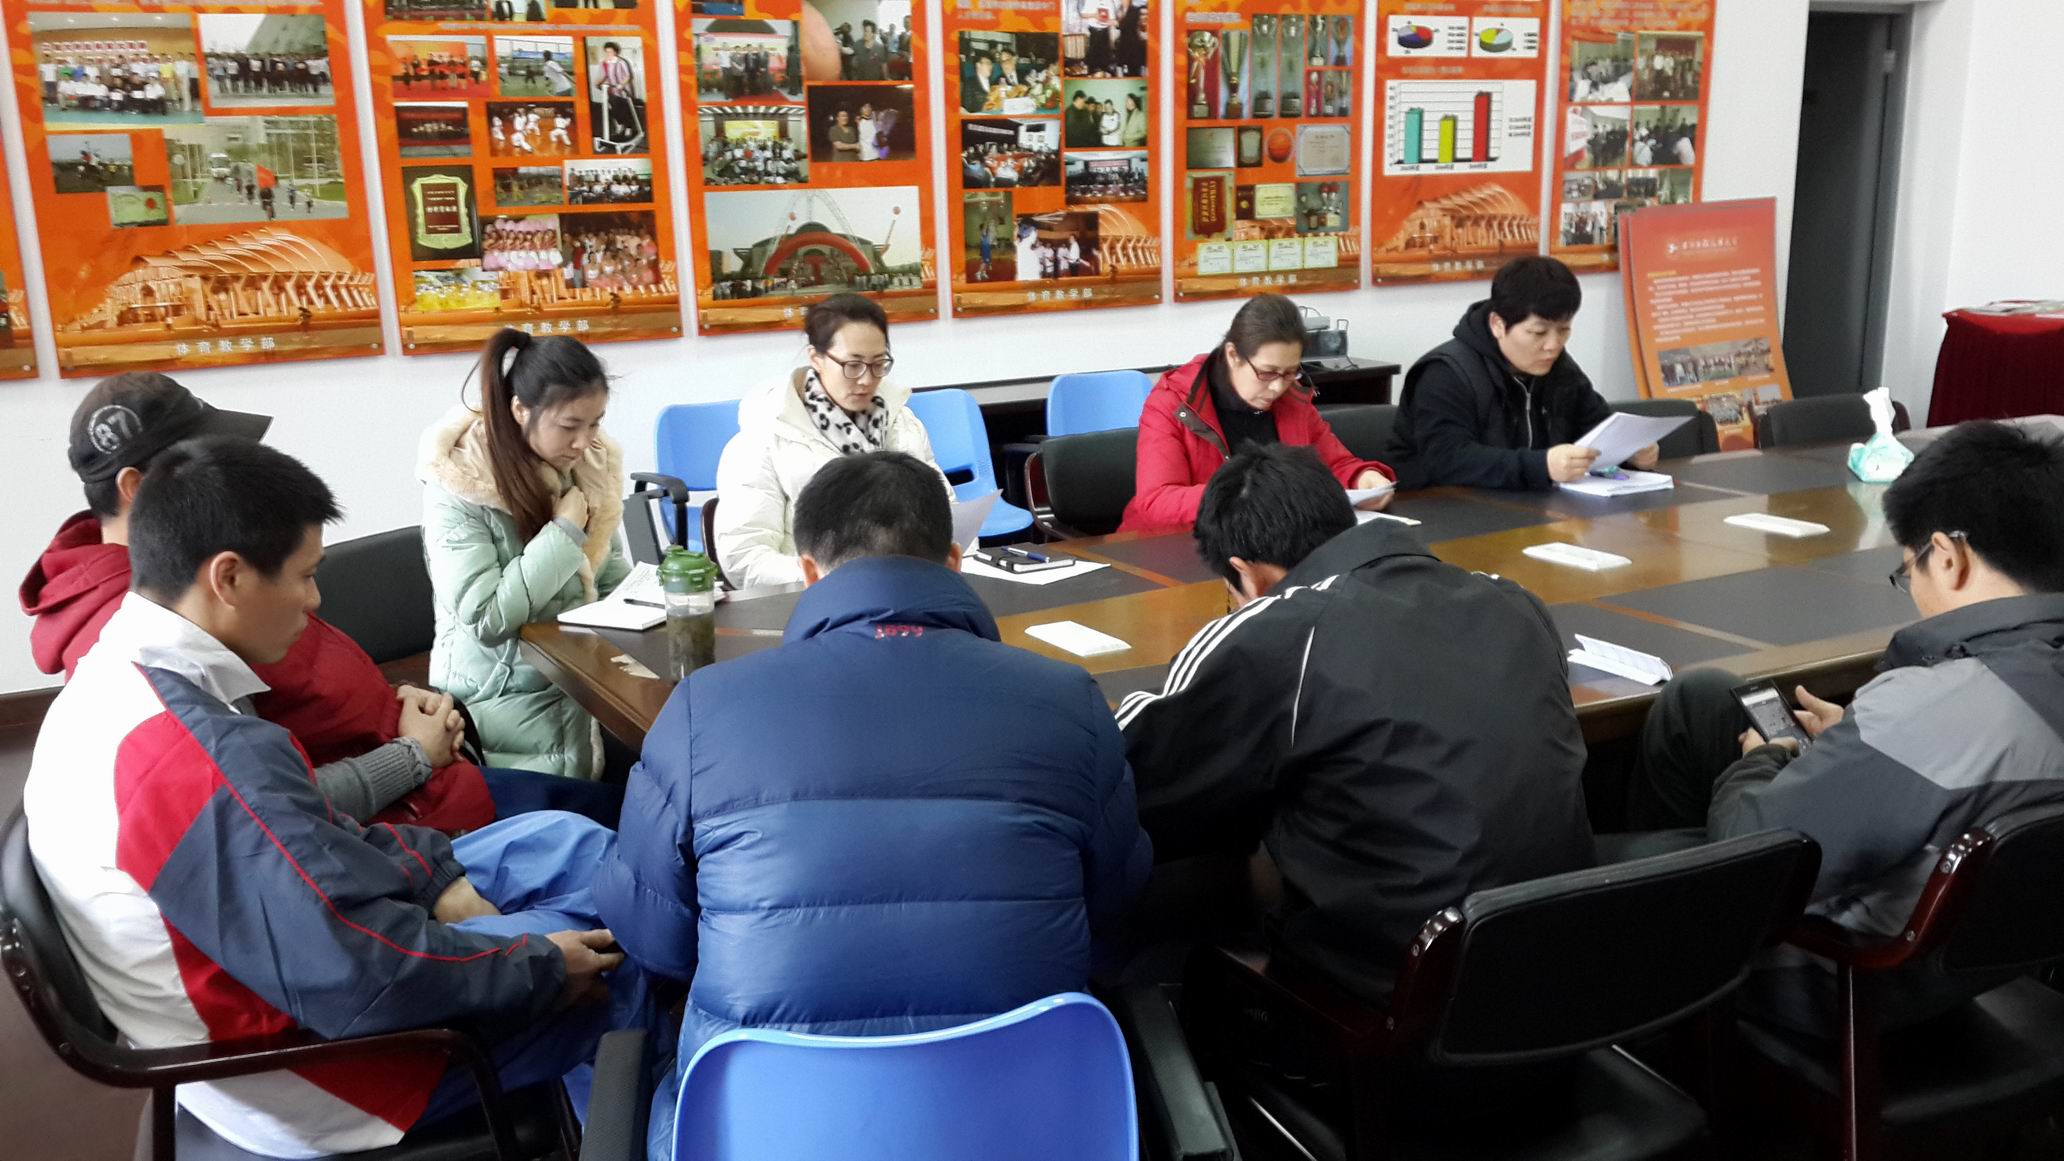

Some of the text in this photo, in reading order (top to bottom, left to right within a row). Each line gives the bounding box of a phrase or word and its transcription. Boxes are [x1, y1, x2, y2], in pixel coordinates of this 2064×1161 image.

[504, 319, 589, 334] 育教学部
[176, 336, 275, 355] 体育教学部
